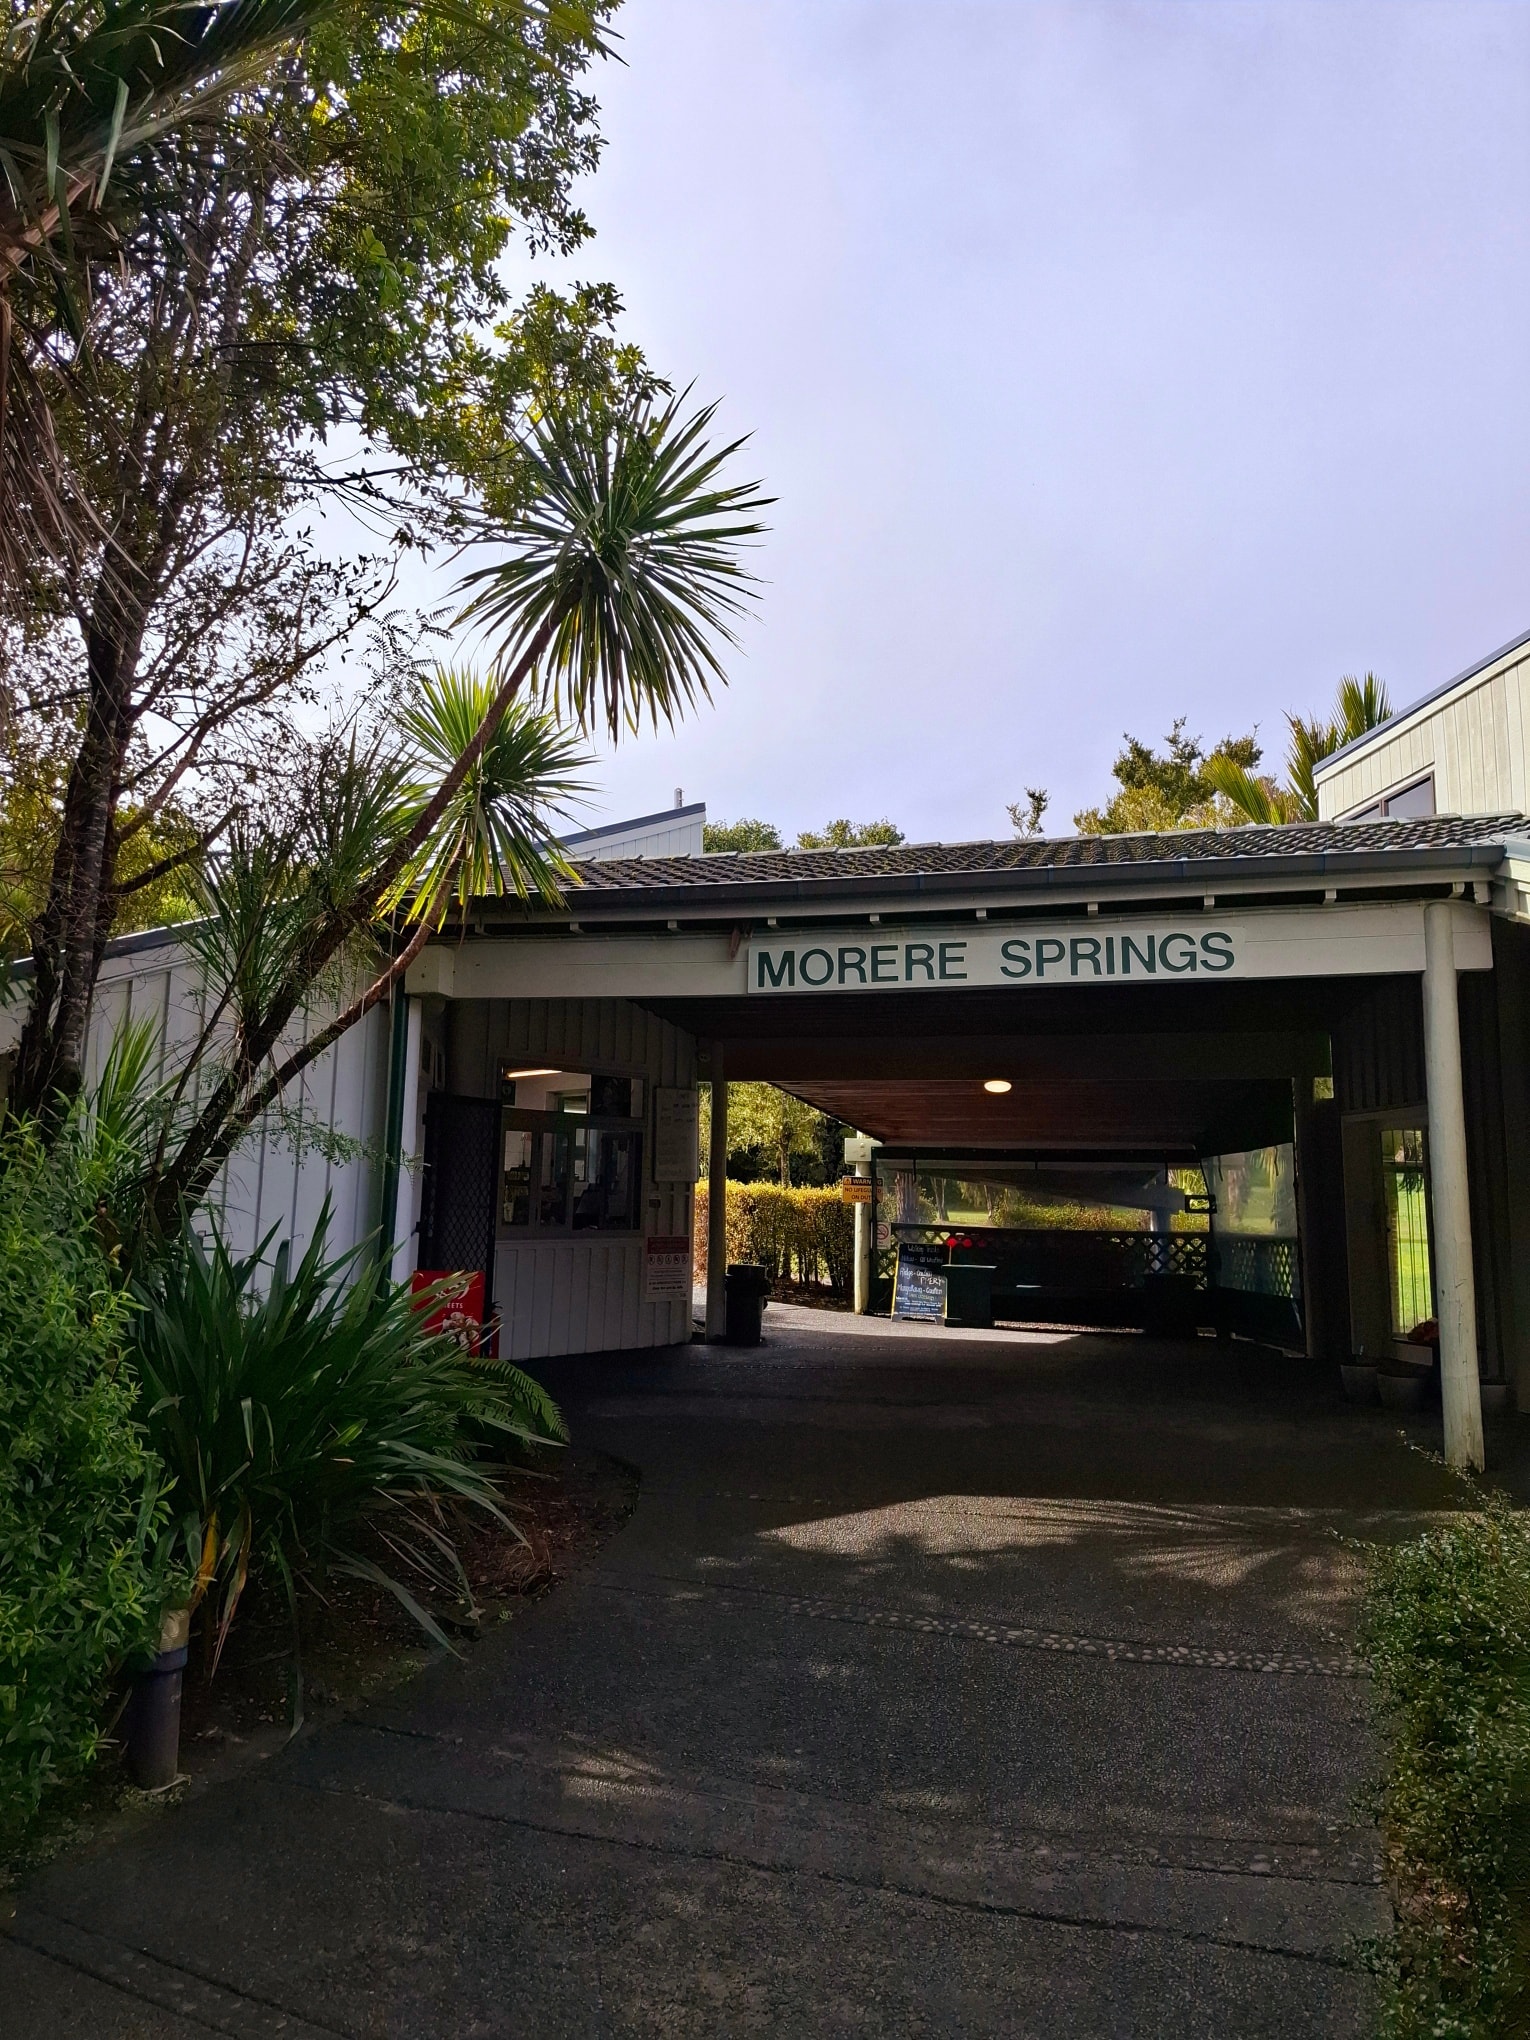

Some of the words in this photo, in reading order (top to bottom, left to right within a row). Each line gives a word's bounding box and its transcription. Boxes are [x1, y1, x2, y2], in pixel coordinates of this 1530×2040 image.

[756, 941, 969, 988] MORERE
[1000, 931, 1236, 979] SPRINGS
[852, 1178, 882, 1186] WARNG
